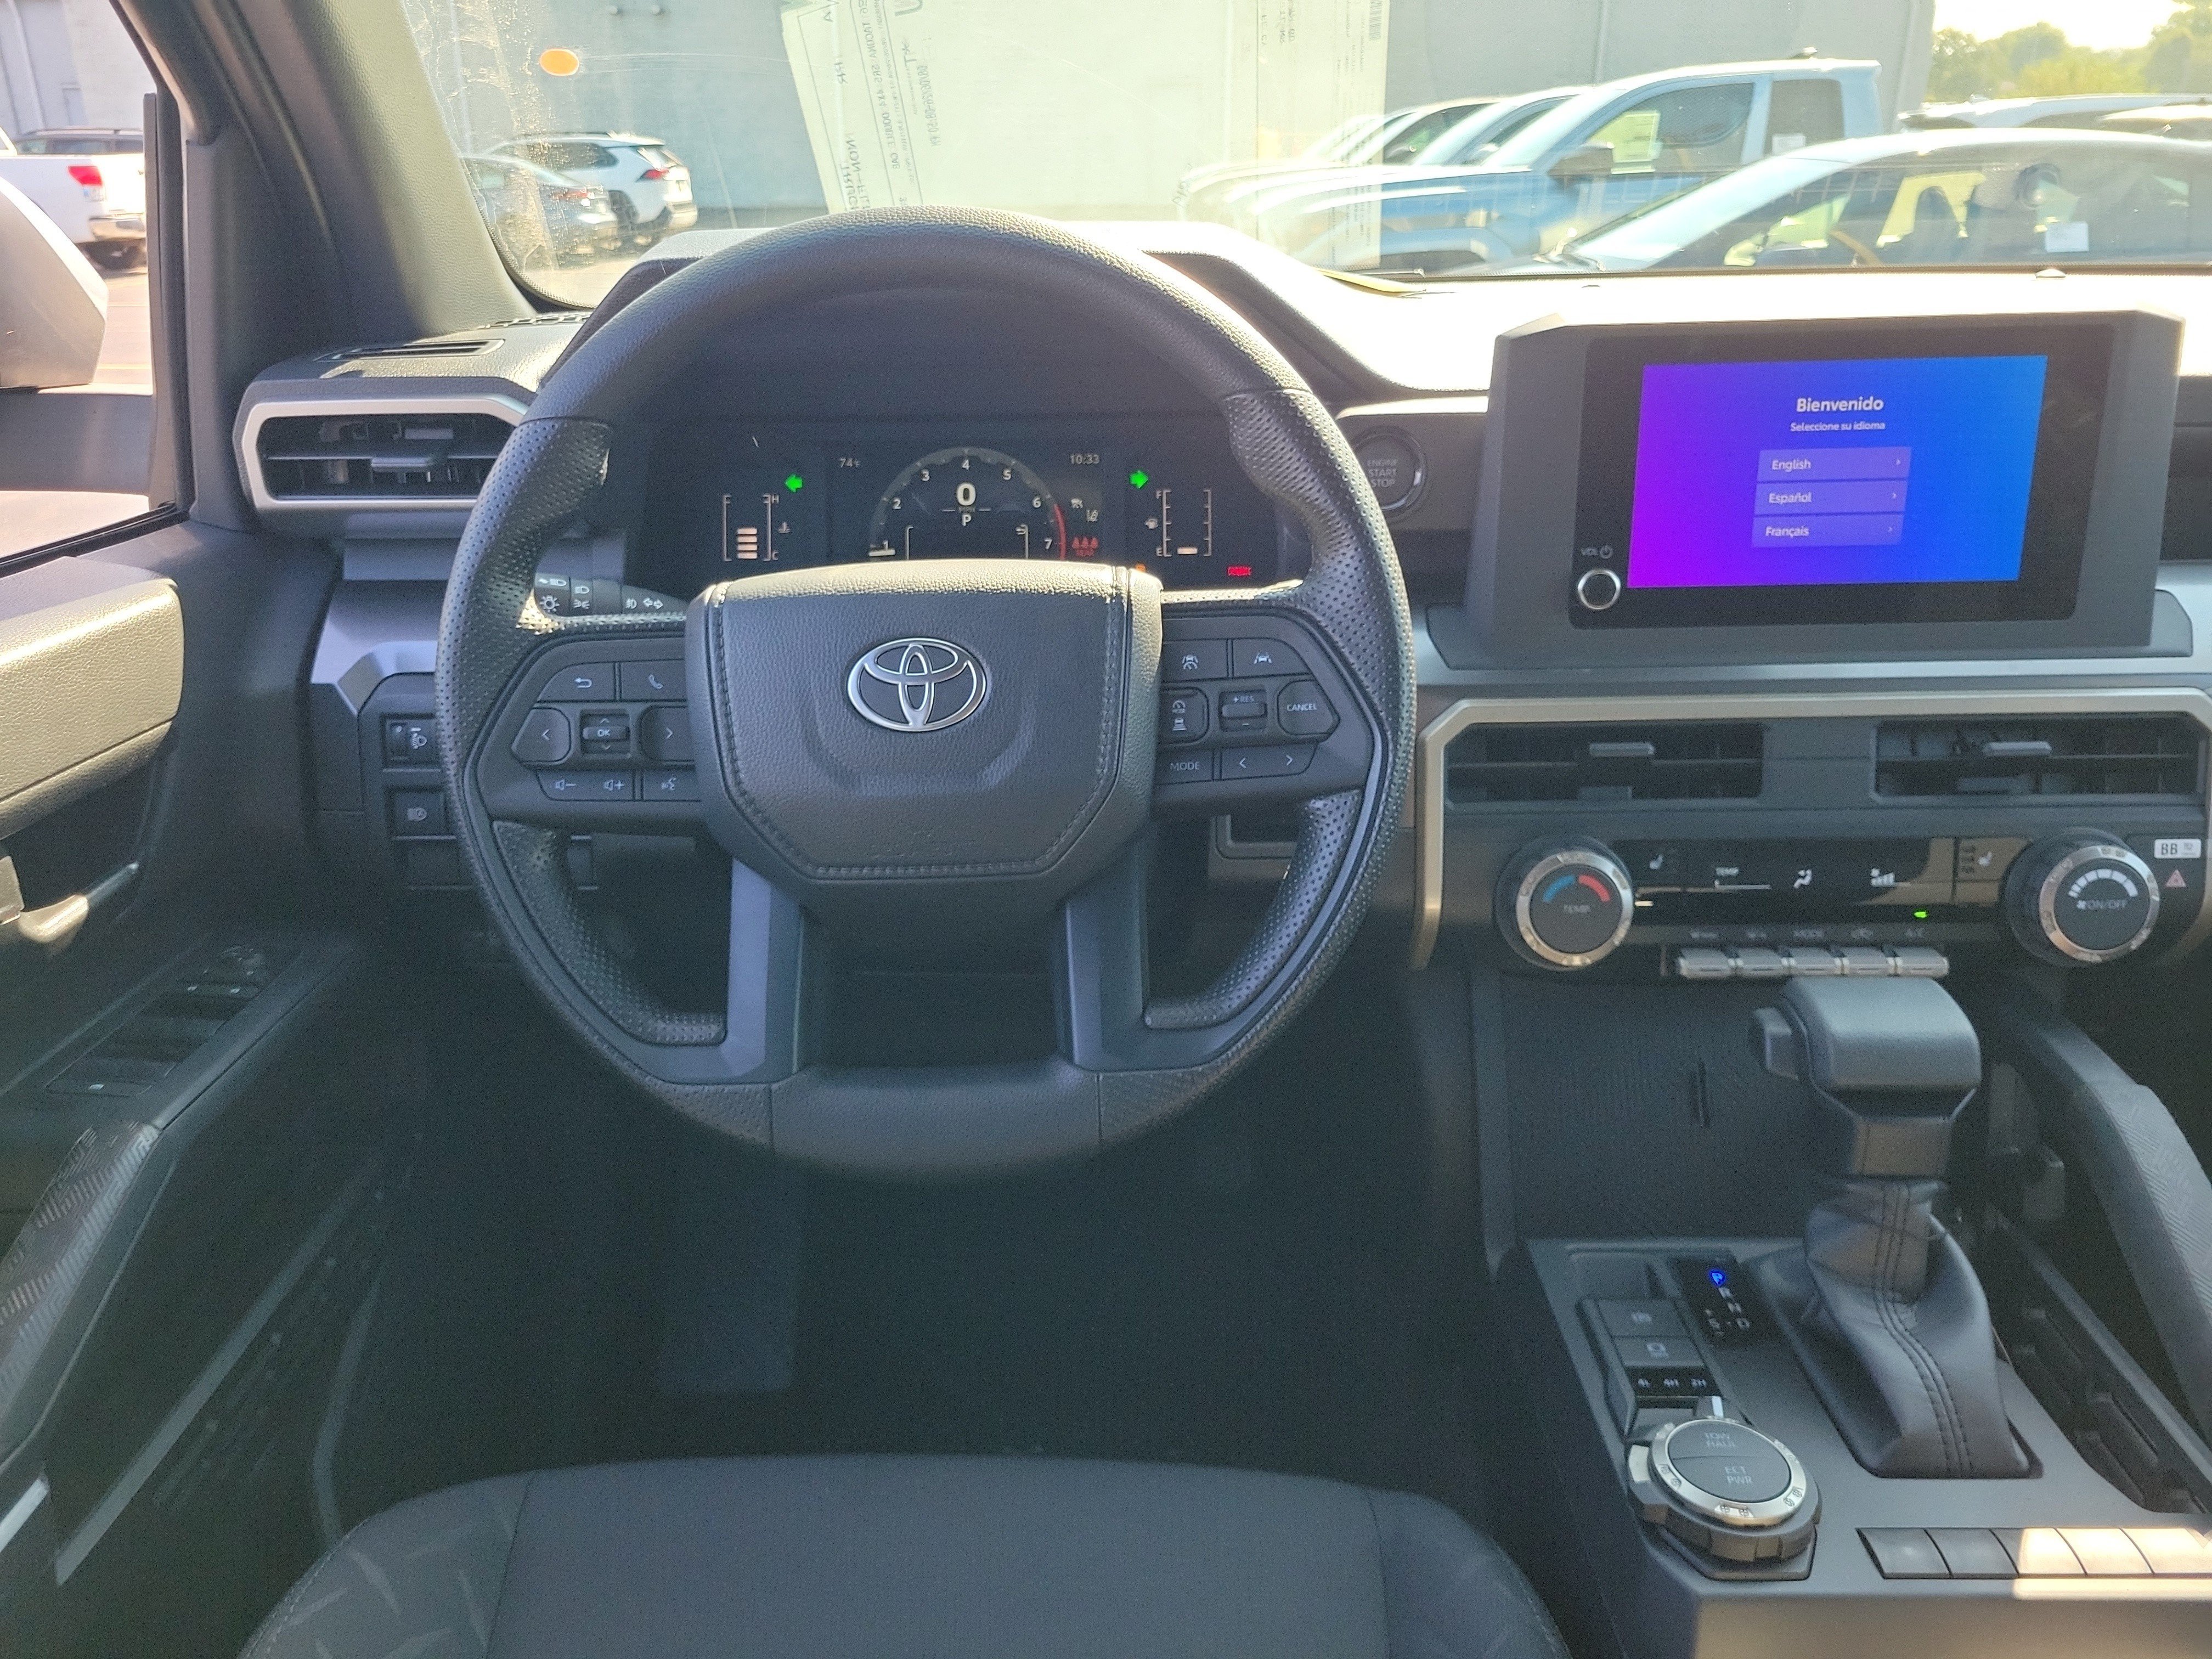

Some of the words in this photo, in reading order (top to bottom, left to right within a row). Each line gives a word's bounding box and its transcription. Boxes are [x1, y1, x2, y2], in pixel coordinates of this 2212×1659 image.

[1797, 396, 1884, 413] Bienvenido
[1790, 421, 1839, 432] Seleccione
[1841, 422, 1852, 431] su
[1854, 421, 1886, 430] idioma
[962, 460, 970, 470] 4
[1070, 454, 1099, 465] 10:33
[1771, 458, 1812, 472] English
[921, 469, 930, 481] 3
[1003, 469, 1012, 481] 5
[1368, 469, 1397, 477] START
[1371, 479, 1396, 488] STOP
[957, 483, 976, 506] 0
[1768, 492, 1812, 505] Español
[893, 497, 901, 509] 2
[1032, 497, 1041, 509] 6
[962, 514, 972, 527] P
[1765, 525, 1809, 538] Français
[883, 540, 889, 549] 1
[1044, 538, 1052, 550] 7
[772, 550, 778, 560] C
[1156, 548, 1163, 556] E
[1286, 703, 1317, 712] CANCEL
[597, 729, 610, 737] OK
[1170, 761, 1200, 771] MODE
[1563, 904, 1591, 914] TEMP
[1724, 1466, 1746, 1475] ECT
[1726, 1475, 1754, 1485] PWR
